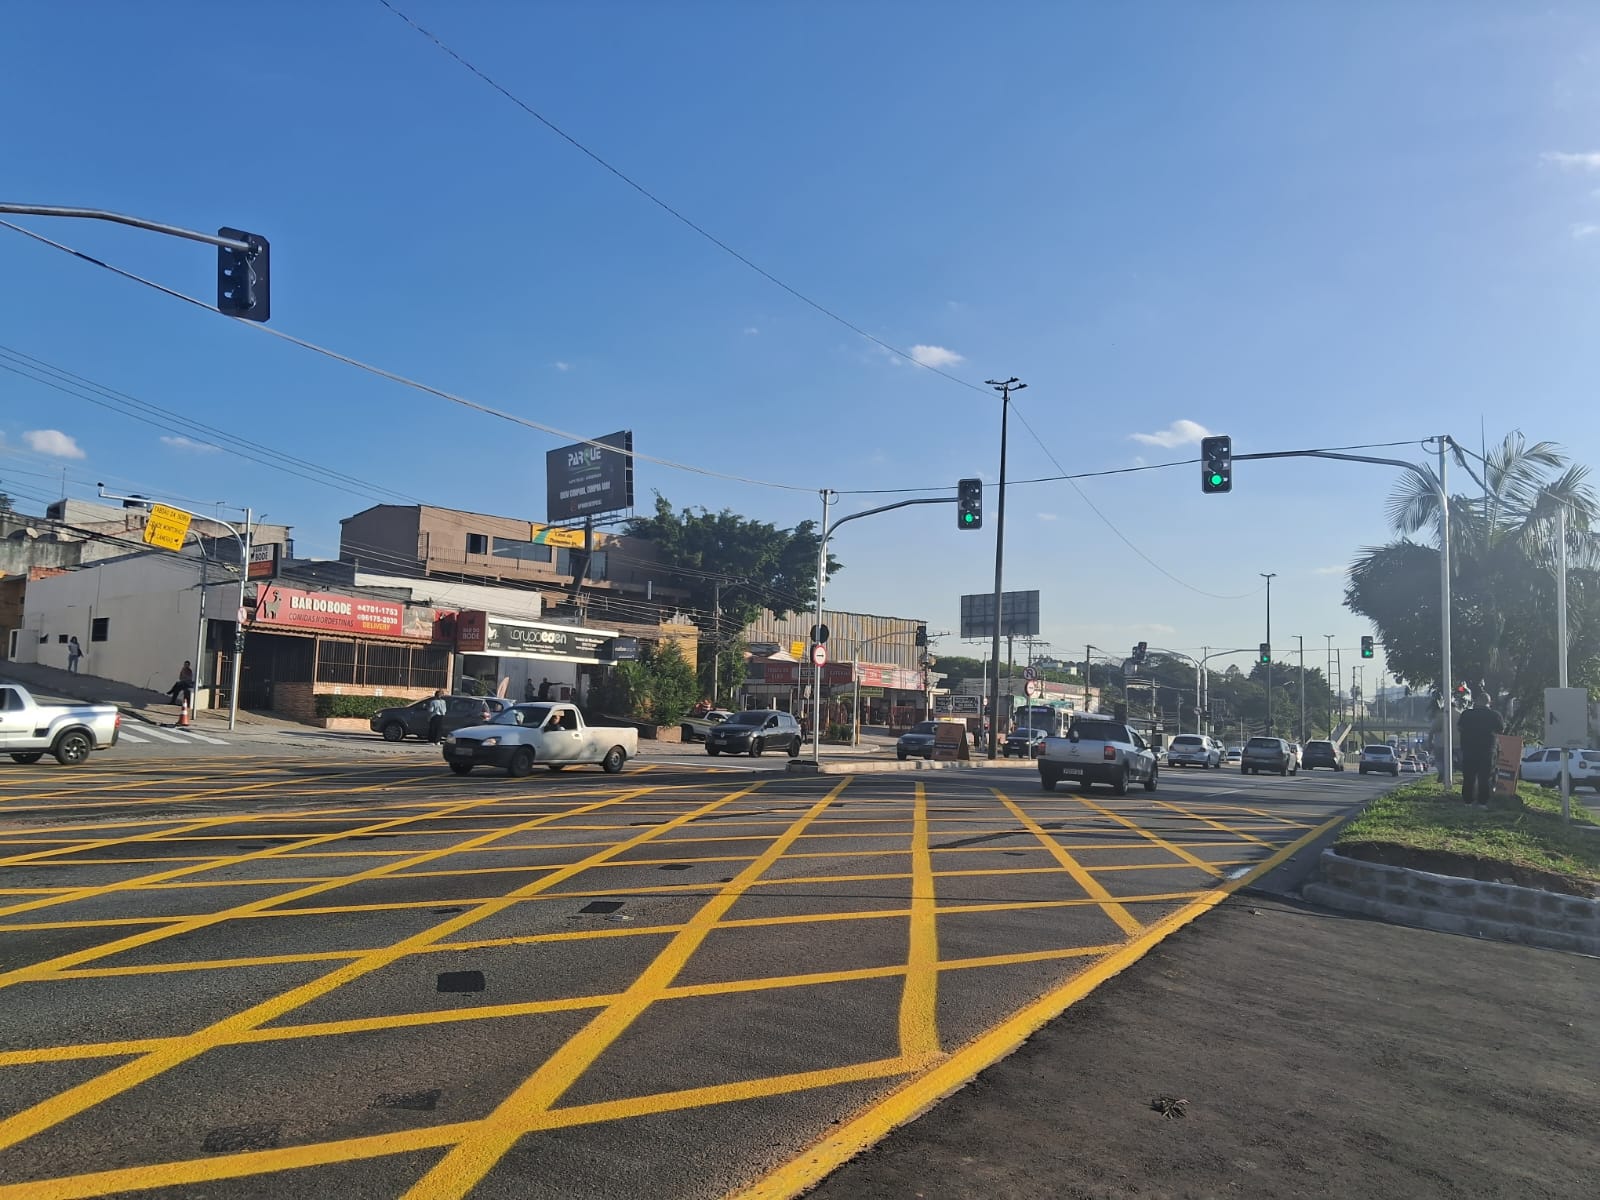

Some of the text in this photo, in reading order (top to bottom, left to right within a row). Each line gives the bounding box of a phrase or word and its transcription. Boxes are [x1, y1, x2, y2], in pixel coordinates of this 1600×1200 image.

[290, 596, 352, 615] BAR DO BODE
[288, 612, 354, 627] COMIDAS NORDESTINAS
[362, 622, 390, 630] DELIVERY
